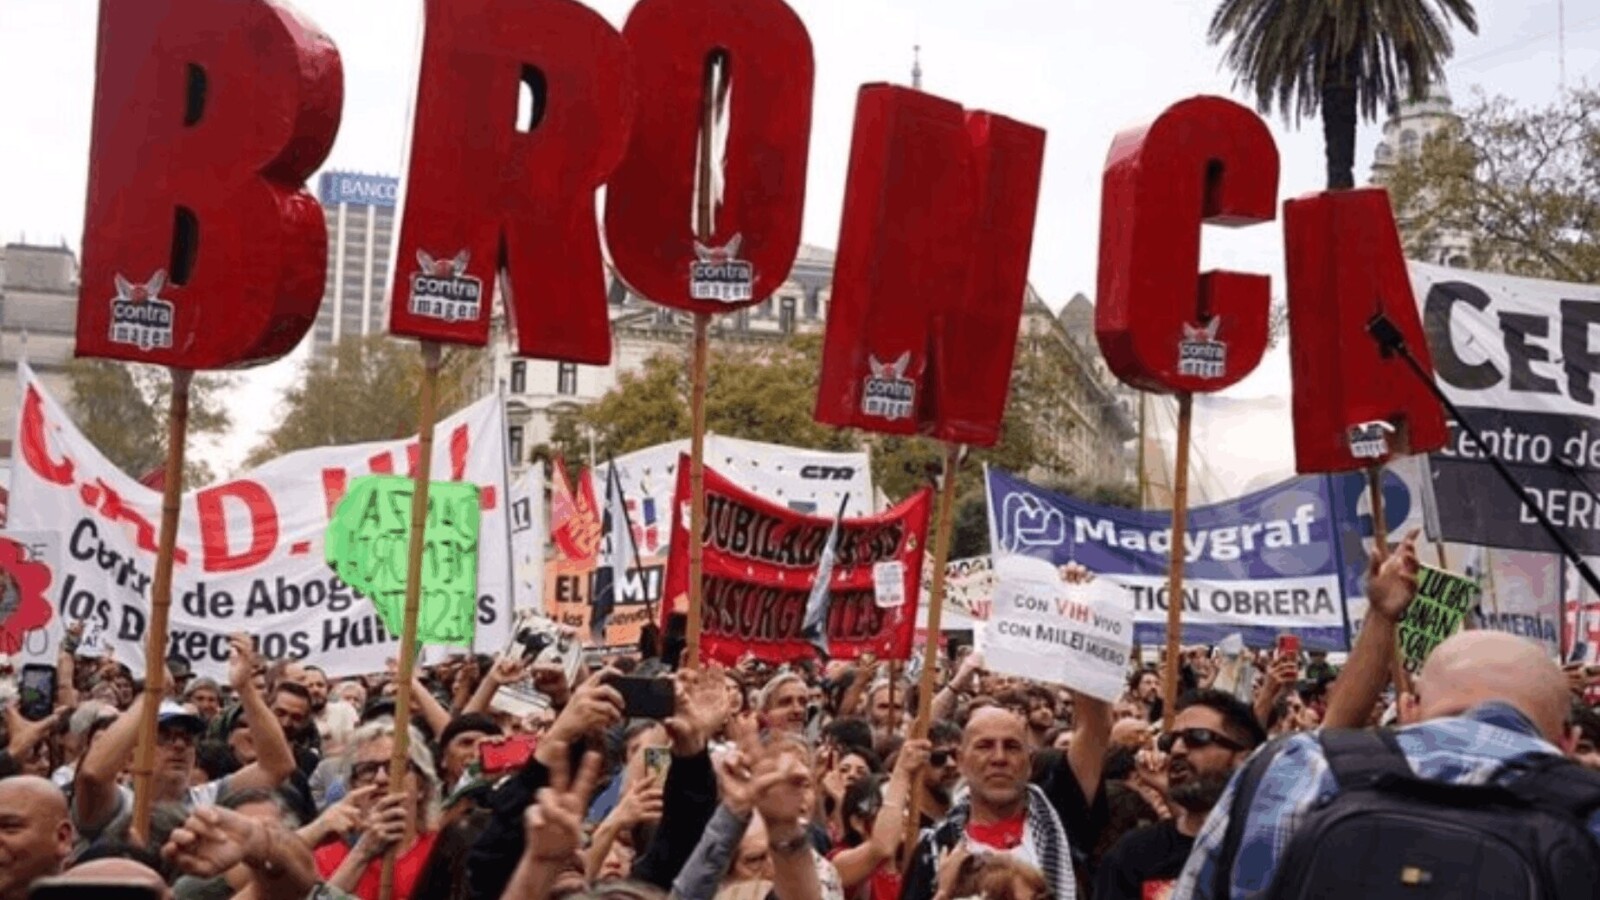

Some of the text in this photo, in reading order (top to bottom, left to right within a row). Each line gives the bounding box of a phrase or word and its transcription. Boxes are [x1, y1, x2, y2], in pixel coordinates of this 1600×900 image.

[342, 178, 397, 198] BANCO
[695, 264, 749, 279] contra
[415, 277, 479, 298] contra
[114, 302, 170, 324] contra
[410, 299, 479, 320] imagen
[1074, 504, 1314, 563] Madygraf
[60, 573, 111, 631] los
[183, 582, 234, 618] de
[556, 575, 583, 603] EL
[1210, 588, 1335, 616] OBRERA
[1014, 594, 1049, 613] CON
[1055, 597, 1089, 623] VIH
[1094, 613, 1122, 635] VIVO
[998, 620, 1032, 640] CON
[1036, 623, 1085, 651] MILEI
